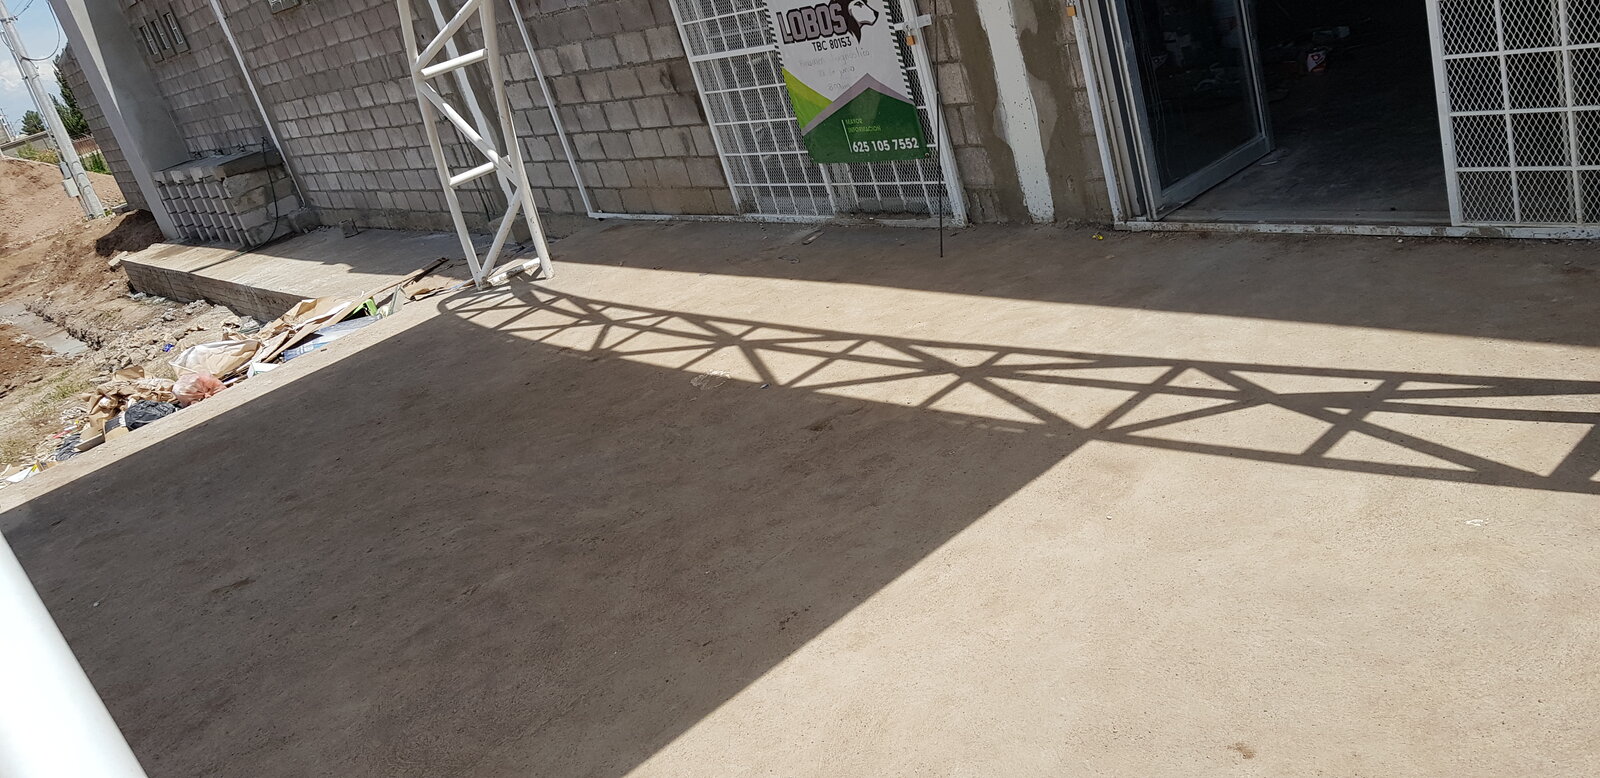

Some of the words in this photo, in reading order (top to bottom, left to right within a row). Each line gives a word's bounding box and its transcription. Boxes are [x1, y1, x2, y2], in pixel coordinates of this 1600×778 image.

[776, 3, 848, 44] LOBOS
[812, 40, 827, 52] TBC
[829, 37, 852, 50] 80153
[852, 141, 870, 153] 625
[871, 140, 890, 151] 105
[892, 137, 919, 150] 7552
